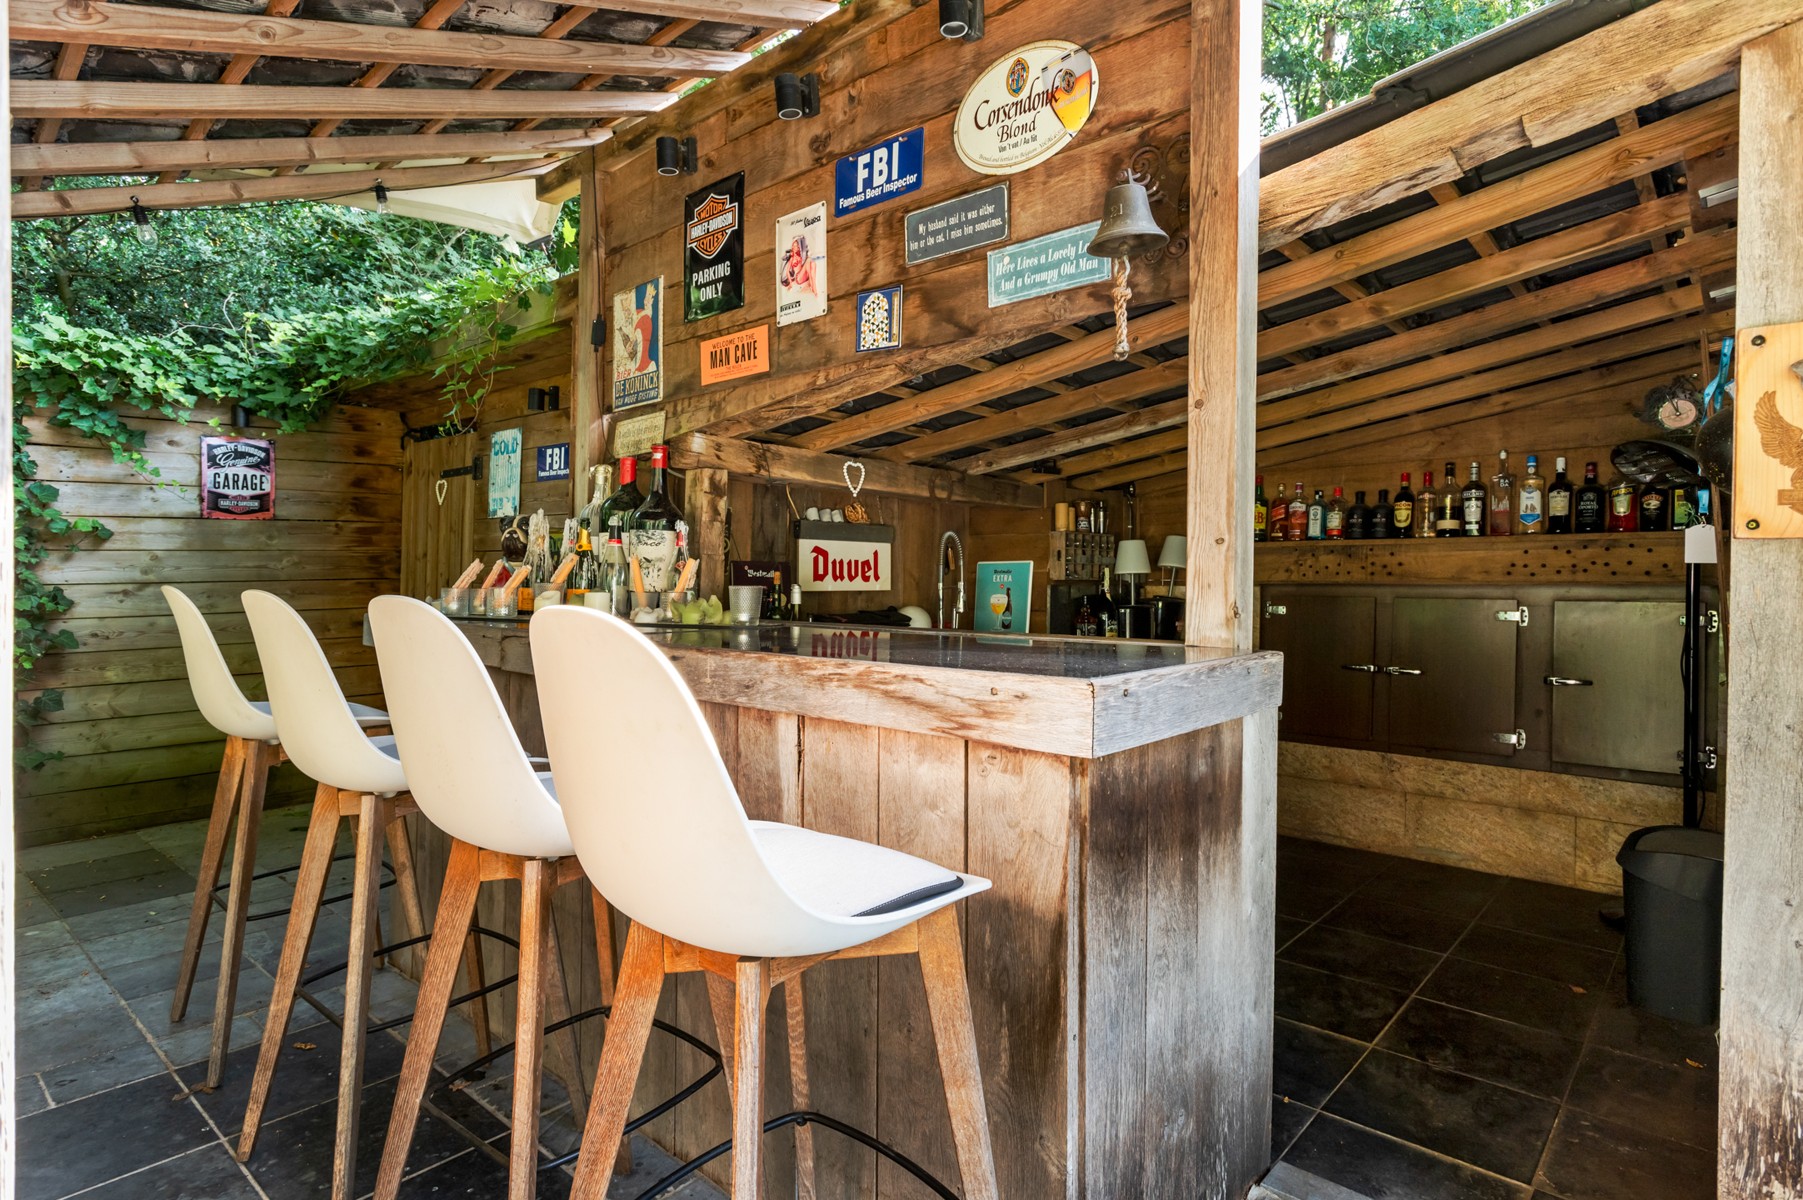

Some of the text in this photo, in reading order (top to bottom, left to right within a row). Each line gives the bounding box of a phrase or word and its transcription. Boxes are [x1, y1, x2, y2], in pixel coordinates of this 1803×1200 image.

[974, 68, 1063, 131] Corsendonk
[996, 111, 1040, 143] Blond
[857, 141, 899, 194] FBI
[839, 173, 918, 209] Famous Beer Inspector
[700, 202, 723, 219] MOTOR
[918, 203, 995, 235] My husband said it was either
[690, 211, 733, 240] HARLEY-DAVIDSON
[909, 240, 919, 251] him
[920, 239, 926, 248] or
[926, 235, 935, 246] the
[946, 229, 949, 241] I
[950, 228, 963, 239] miss
[963, 224, 973, 236] him
[699, 231, 723, 252] CYCLES
[996, 260, 1016, 277] Here
[1017, 254, 1039, 270] Lives
[1040, 253, 1046, 264] a
[1048, 243, 1076, 263] Lovely
[692, 261, 731, 287] PARKING
[999, 257, 1098, 292] And a Grumpy Old Man
[700, 281, 723, 302] ONLY
[712, 332, 755, 350] WELCOME TO THE
[710, 340, 757, 370] MAN CAVE
[615, 371, 659, 397] DE KONINCK
[616, 368, 631, 380] BIER
[638, 388, 658, 401] GISTING
[212, 444, 266, 459] HARLEY-DAVIDSON
[493, 437, 518, 456] COLD
[546, 447, 565, 471] FBI
[216, 452, 261, 473] Genuine
[213, 472, 266, 491] GARAGE
[747, 569, 775, 578] Westmall
[811, 545, 880, 582] Duvel
[993, 574, 1013, 583] EXTRA
